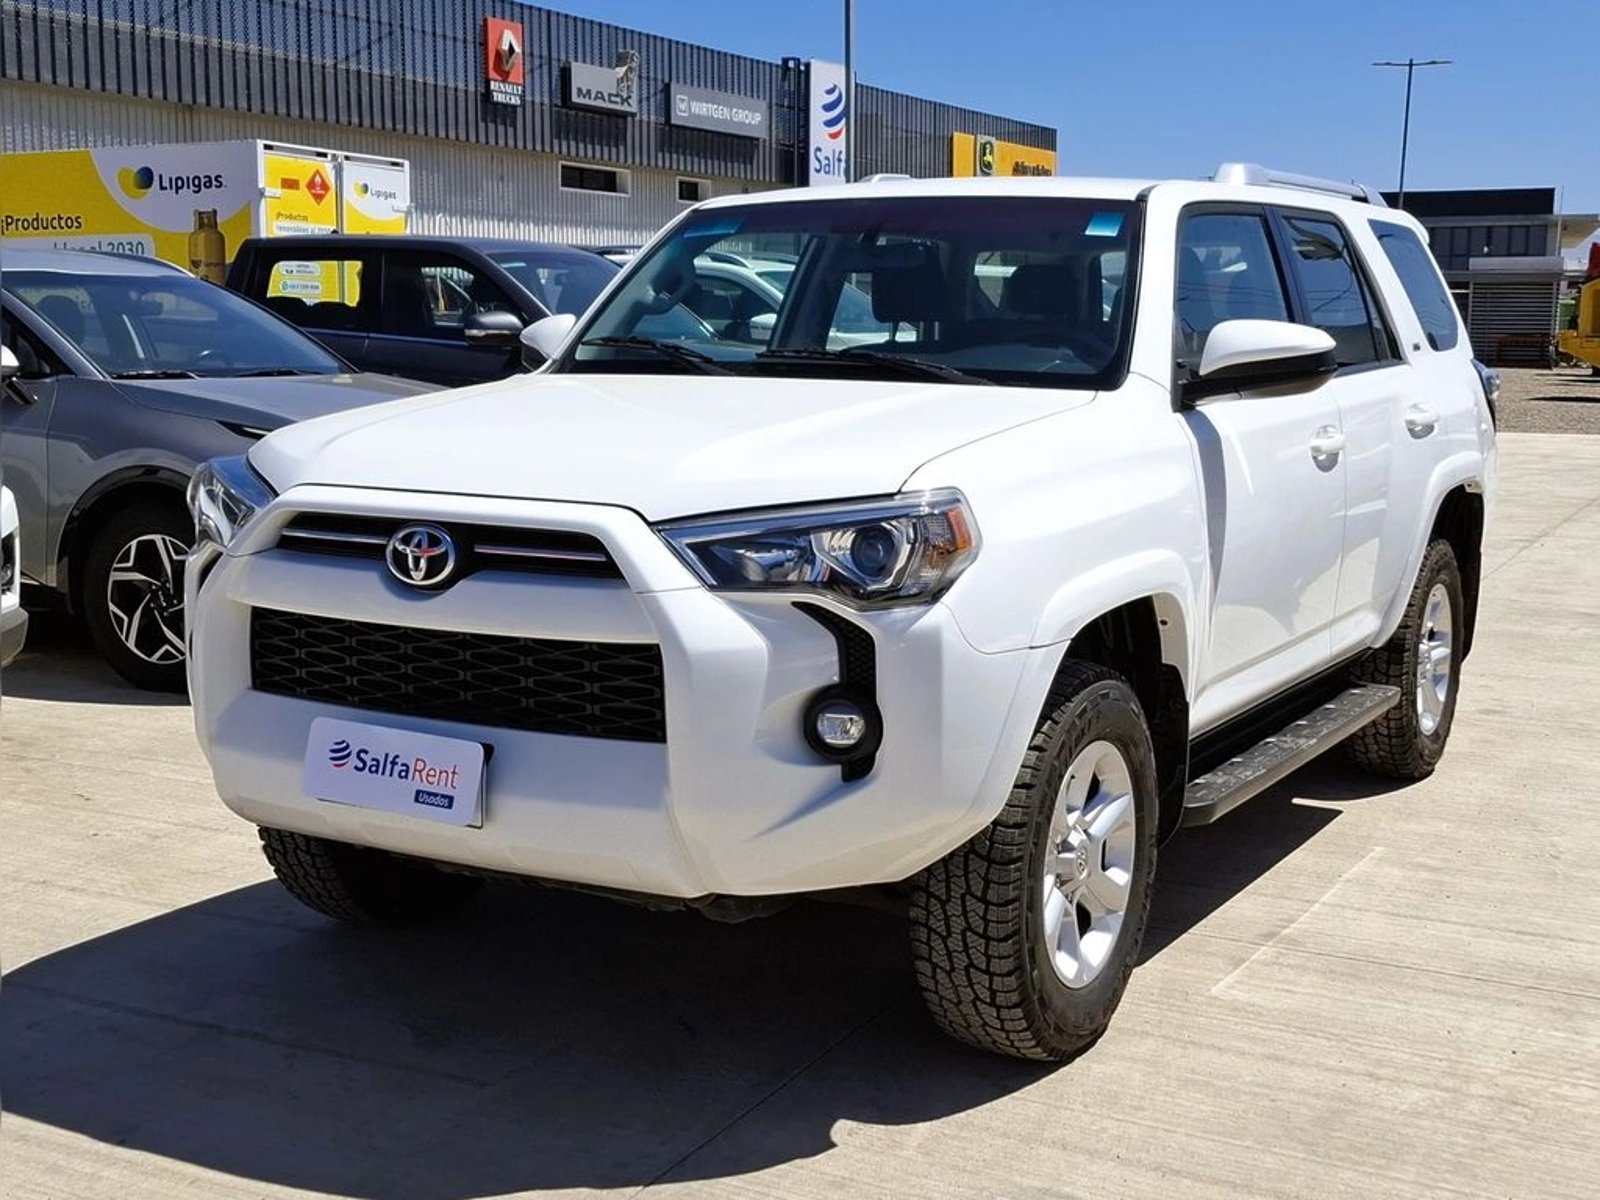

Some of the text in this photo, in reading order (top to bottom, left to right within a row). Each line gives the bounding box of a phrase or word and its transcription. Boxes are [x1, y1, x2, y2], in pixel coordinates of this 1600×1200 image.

[490, 80, 522, 95] RENAULT
[492, 91, 521, 105] TRUCKS
[576, 87, 633, 108] MACK
[690, 100, 731, 120] WIRTGEN
[732, 108, 761, 125] GROUP
[158, 173, 224, 195] Lipigas
[0, 212, 83, 236] ¡Productos
[353, 748, 459, 790] SalfaRent
[418, 791, 450, 807] Usados
